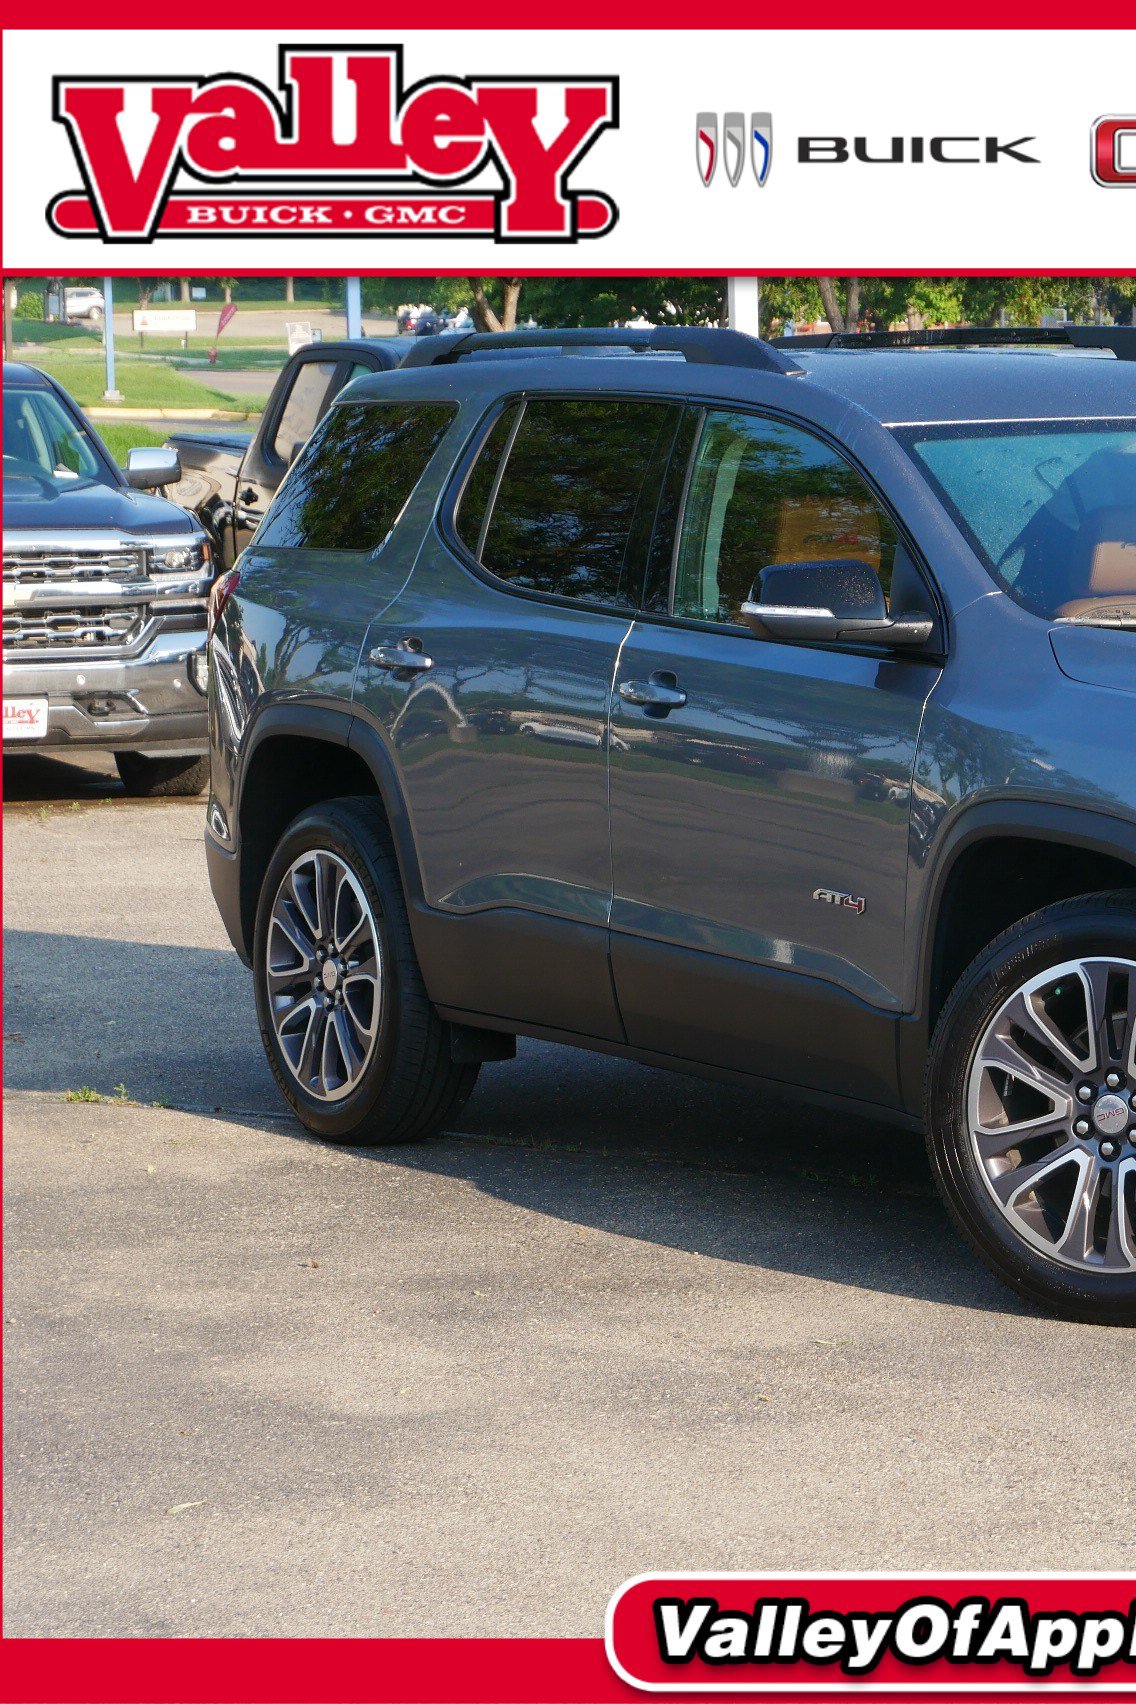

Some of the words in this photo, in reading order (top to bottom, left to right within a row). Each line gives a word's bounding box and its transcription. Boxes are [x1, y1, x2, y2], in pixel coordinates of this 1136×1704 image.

[3, 706, 41, 724] lley
[812, 888, 866, 914] AT4
[1097, 1107, 1125, 1122] GMC
